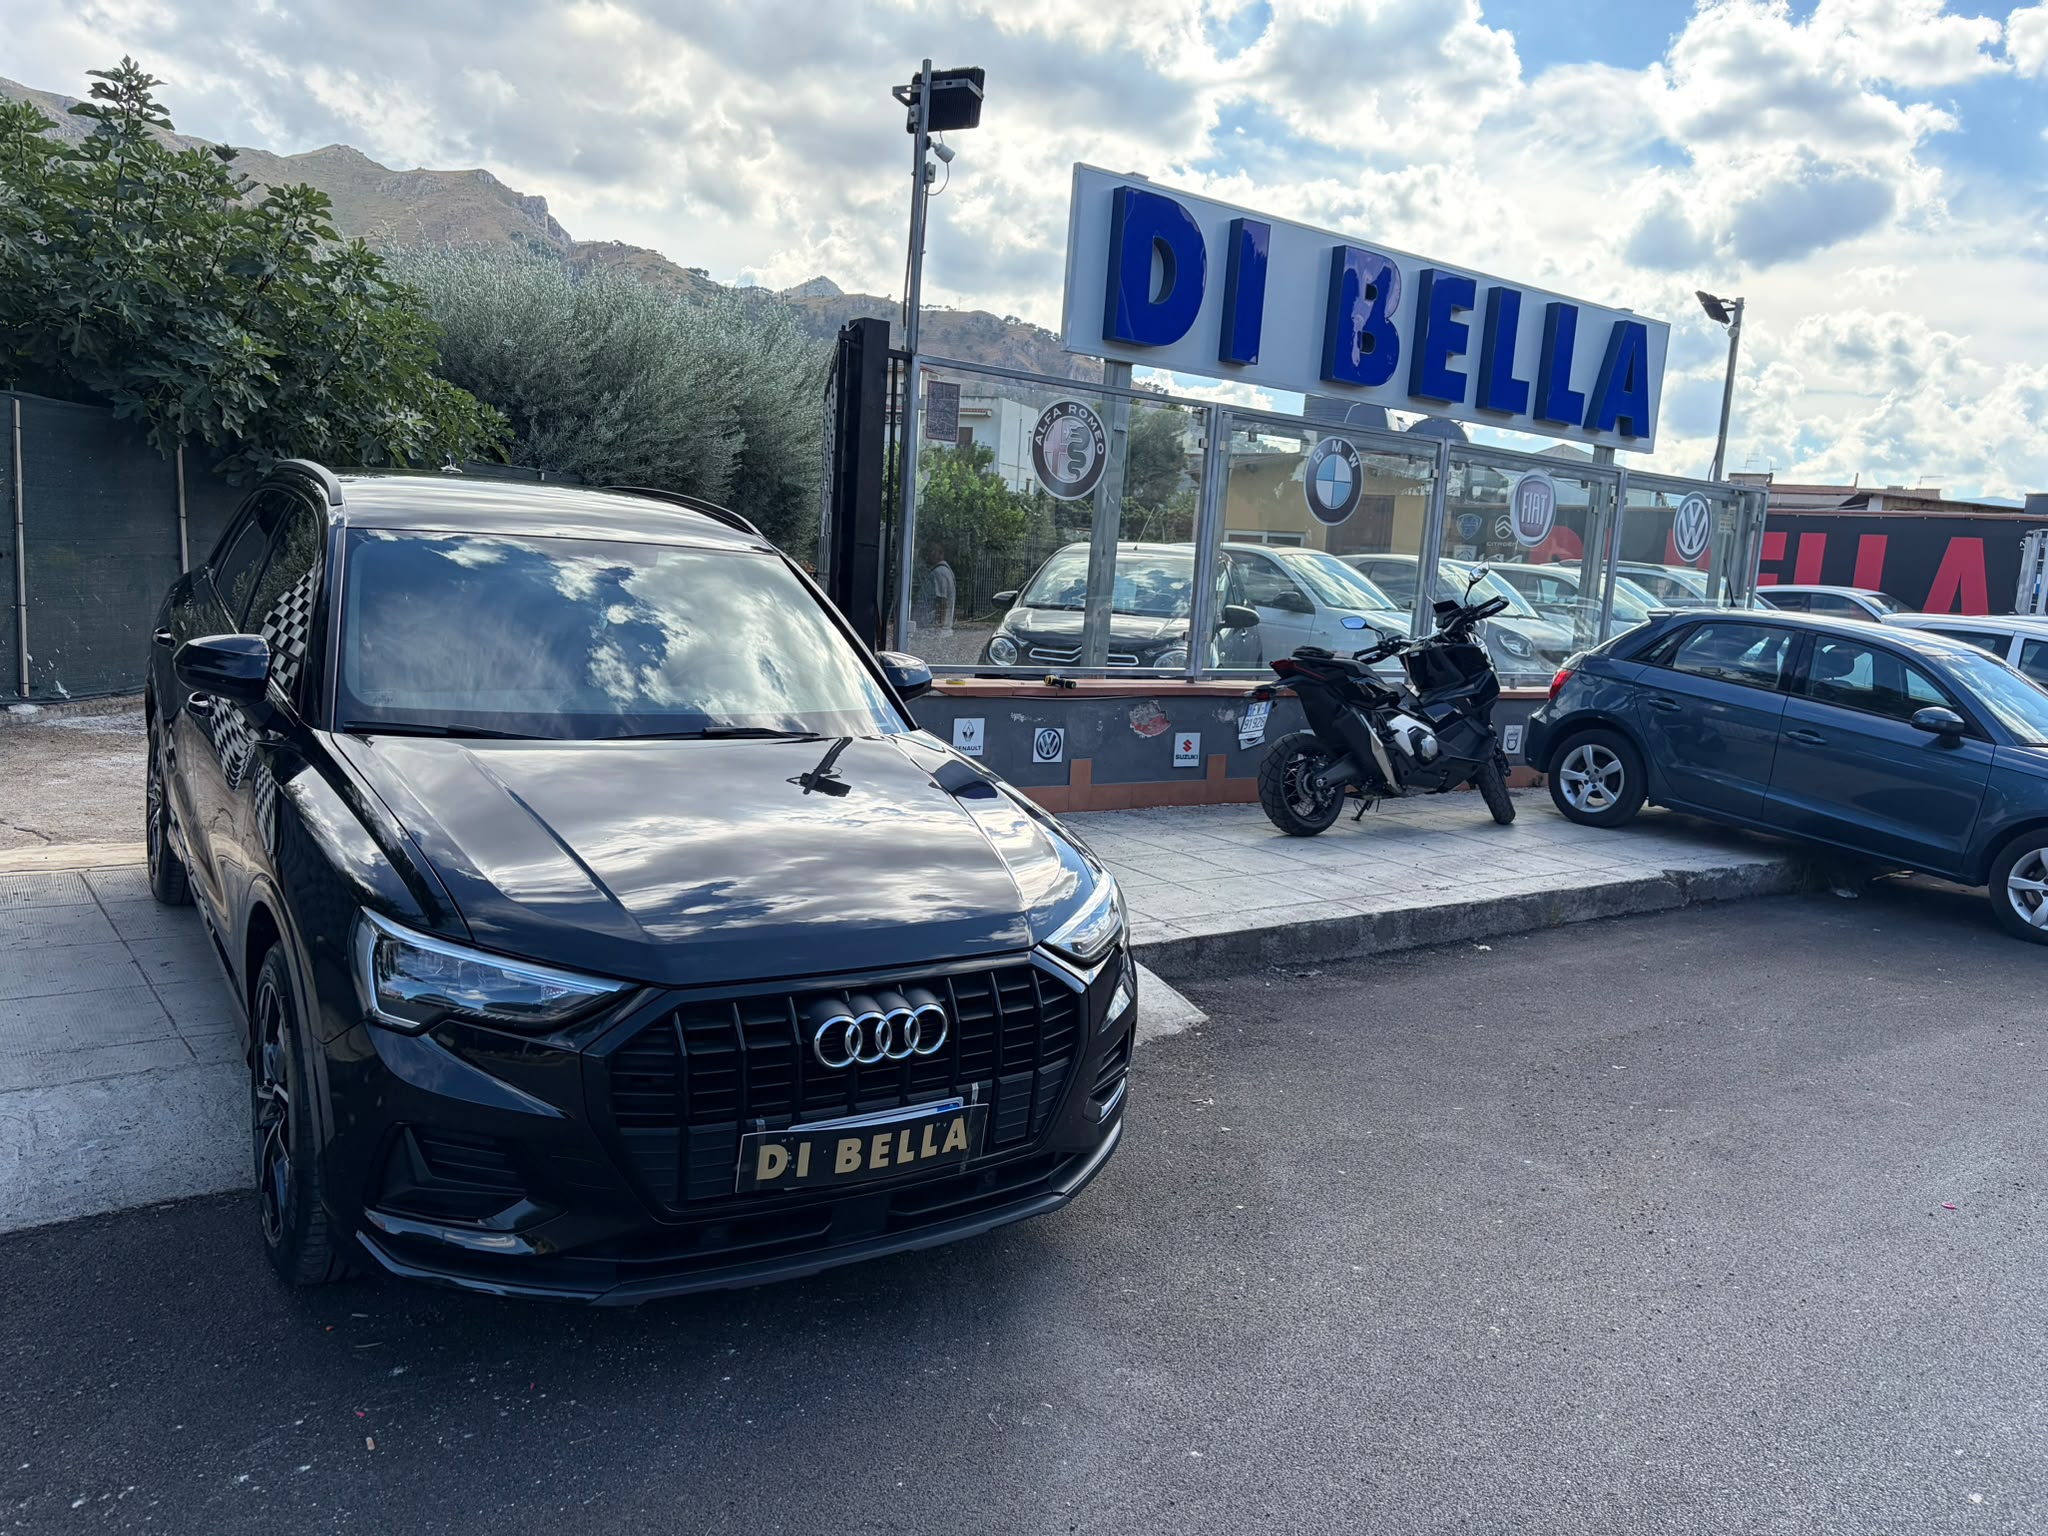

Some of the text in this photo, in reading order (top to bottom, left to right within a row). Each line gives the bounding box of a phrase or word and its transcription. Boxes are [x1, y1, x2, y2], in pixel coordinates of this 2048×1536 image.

[1103, 185, 1650, 438] DI BELLA
[1035, 404, 1105, 455] ALFA ROMEO
[1313, 440, 1359, 468] BMW
[1521, 491, 1548, 525] FIAT
[756, 1117, 968, 1181] DI BELLA
